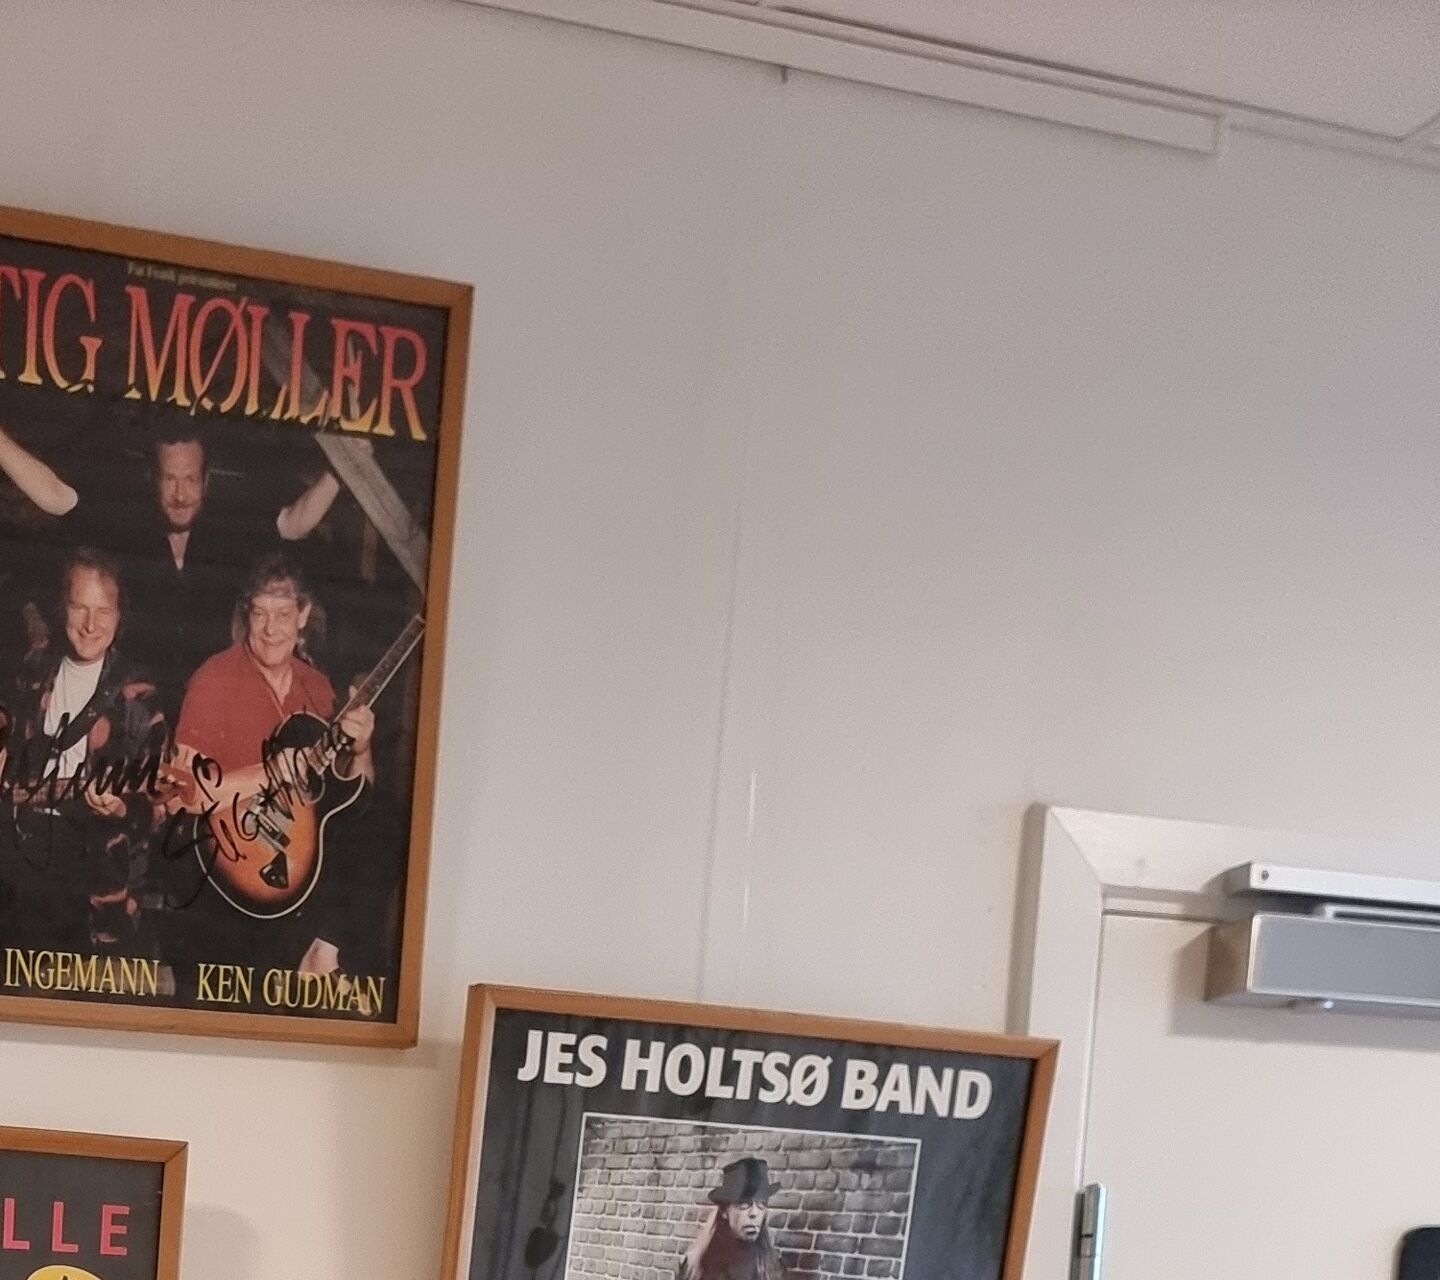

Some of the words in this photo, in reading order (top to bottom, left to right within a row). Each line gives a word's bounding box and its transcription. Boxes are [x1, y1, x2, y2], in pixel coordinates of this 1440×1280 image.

[124, 284, 428, 442] MØLLER
[3, 947, 160, 998] INGEMANN
[196, 962, 255, 1004] KEN
[263, 968, 387, 1014] GUDMAN
[517, 1029, 608, 1089] JES
[621, 1038, 833, 1107] HOLTSØ
[841, 1058, 994, 1121] BAND
